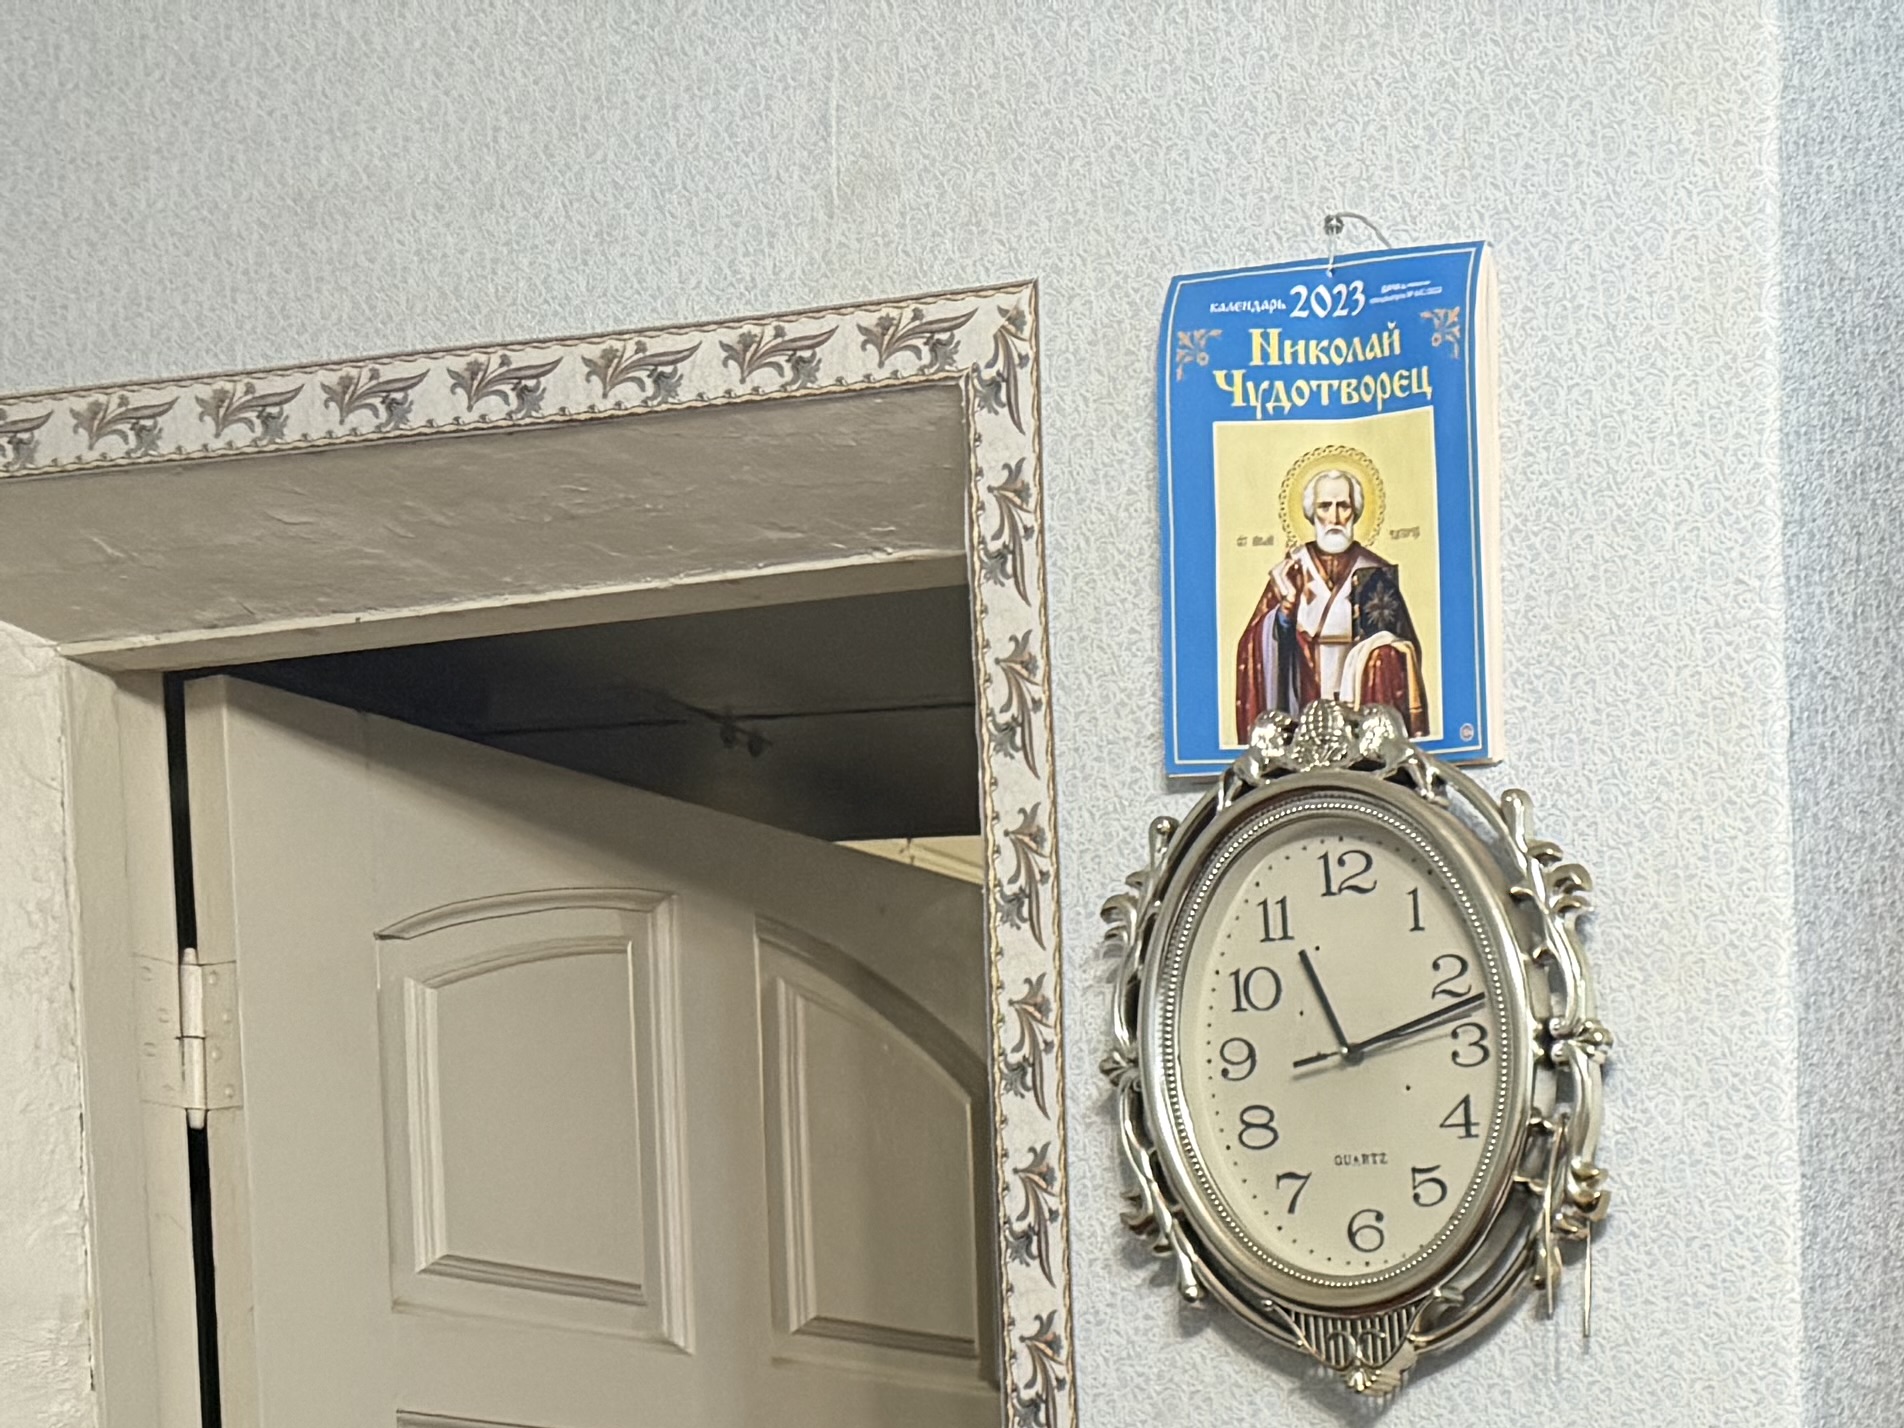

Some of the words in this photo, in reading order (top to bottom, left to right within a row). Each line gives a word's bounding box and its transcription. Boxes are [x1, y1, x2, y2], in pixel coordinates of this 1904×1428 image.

[1289, 279, 1367, 319] 2023
[1318, 849, 1378, 897] 12
[1256, 895, 1295, 943] 11
[1406, 887, 1426, 932] 1
[1229, 966, 1283, 1013] 10
[1431, 953, 1472, 1000] 2
[1219, 1037, 1257, 1082] 9
[1450, 1021, 1491, 1068] 3
[1237, 1104, 1280, 1150] 8
[1438, 1093, 1480, 1140] 4
[1333, 1151, 1389, 1167] QUARTZ
[1275, 1171, 1313, 1215] 7
[1410, 1164, 1448, 1208] 5
[1346, 1208, 1385, 1253] 6
